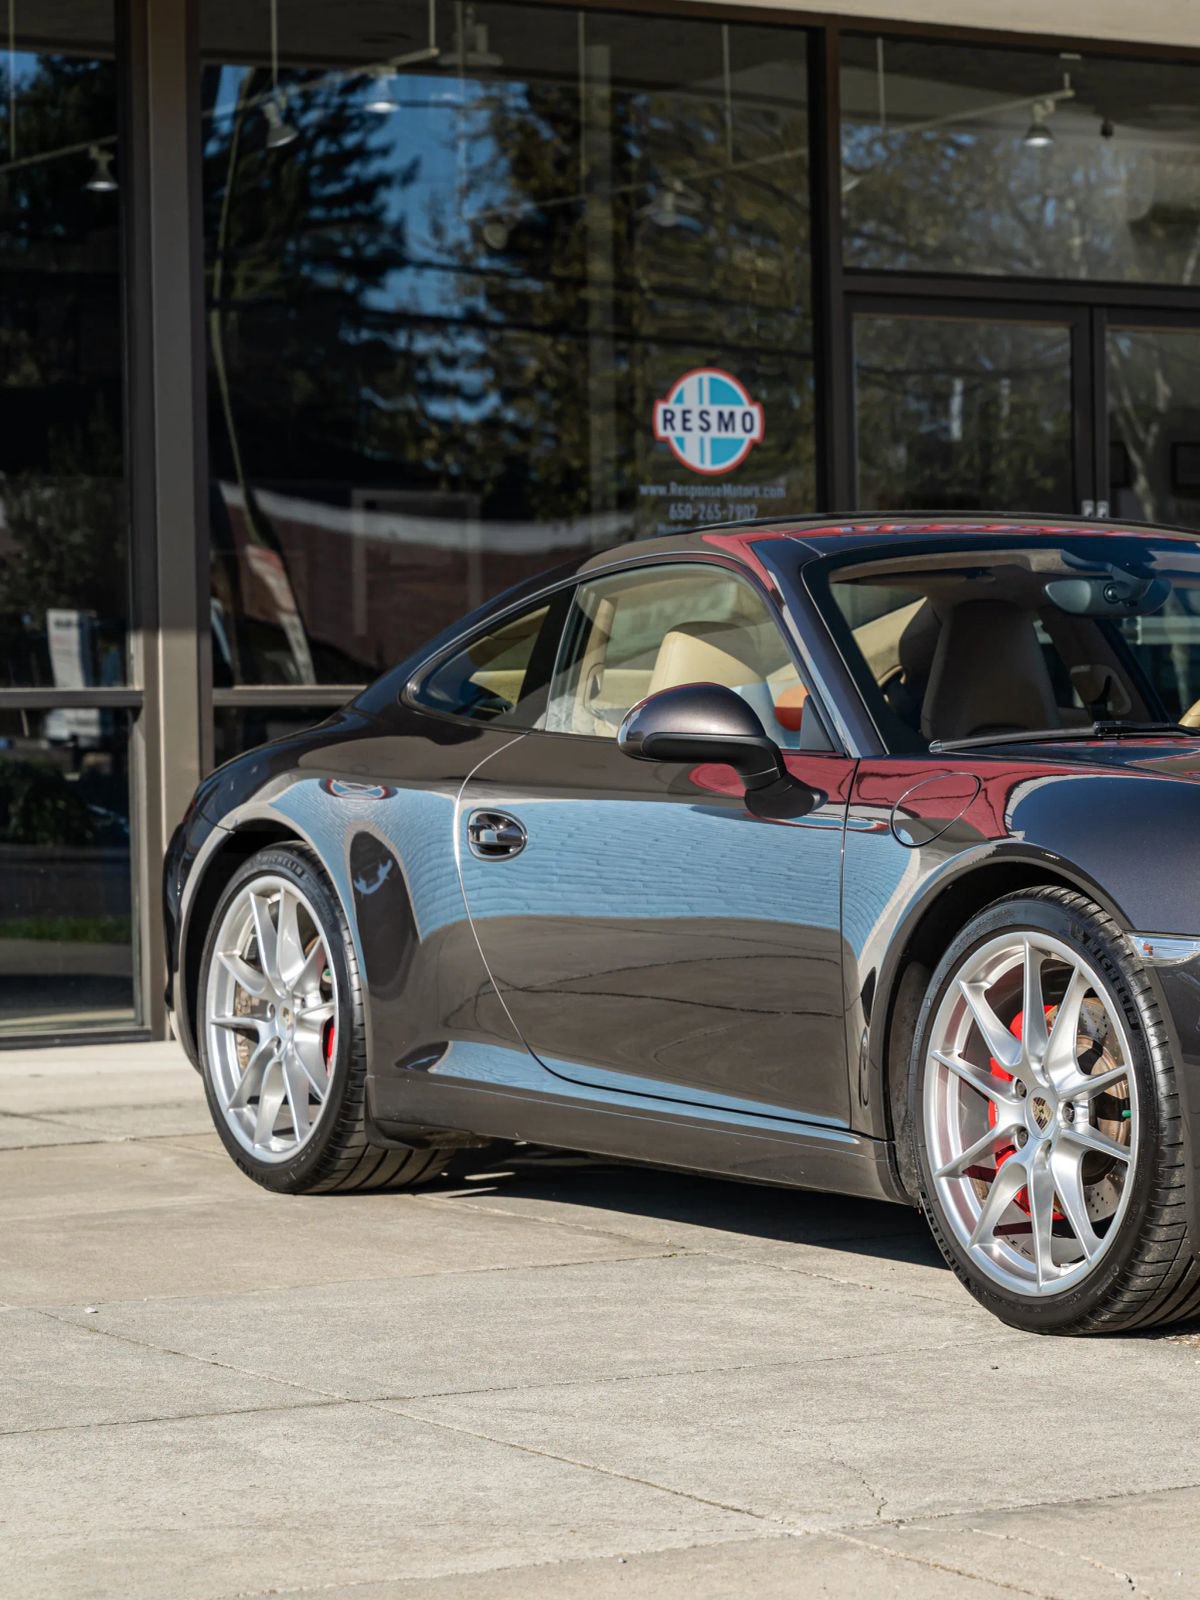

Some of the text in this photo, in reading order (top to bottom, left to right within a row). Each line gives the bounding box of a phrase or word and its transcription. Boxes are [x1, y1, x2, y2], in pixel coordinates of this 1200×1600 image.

[663, 409, 755, 433] RESMO
[639, 482, 785, 499] www.ResponseMotors.com
[669, 503, 758, 520] 650-265-7902
[262, 854, 303, 876] MICHELIN
[1086, 939, 1139, 1026] MICHELIN
